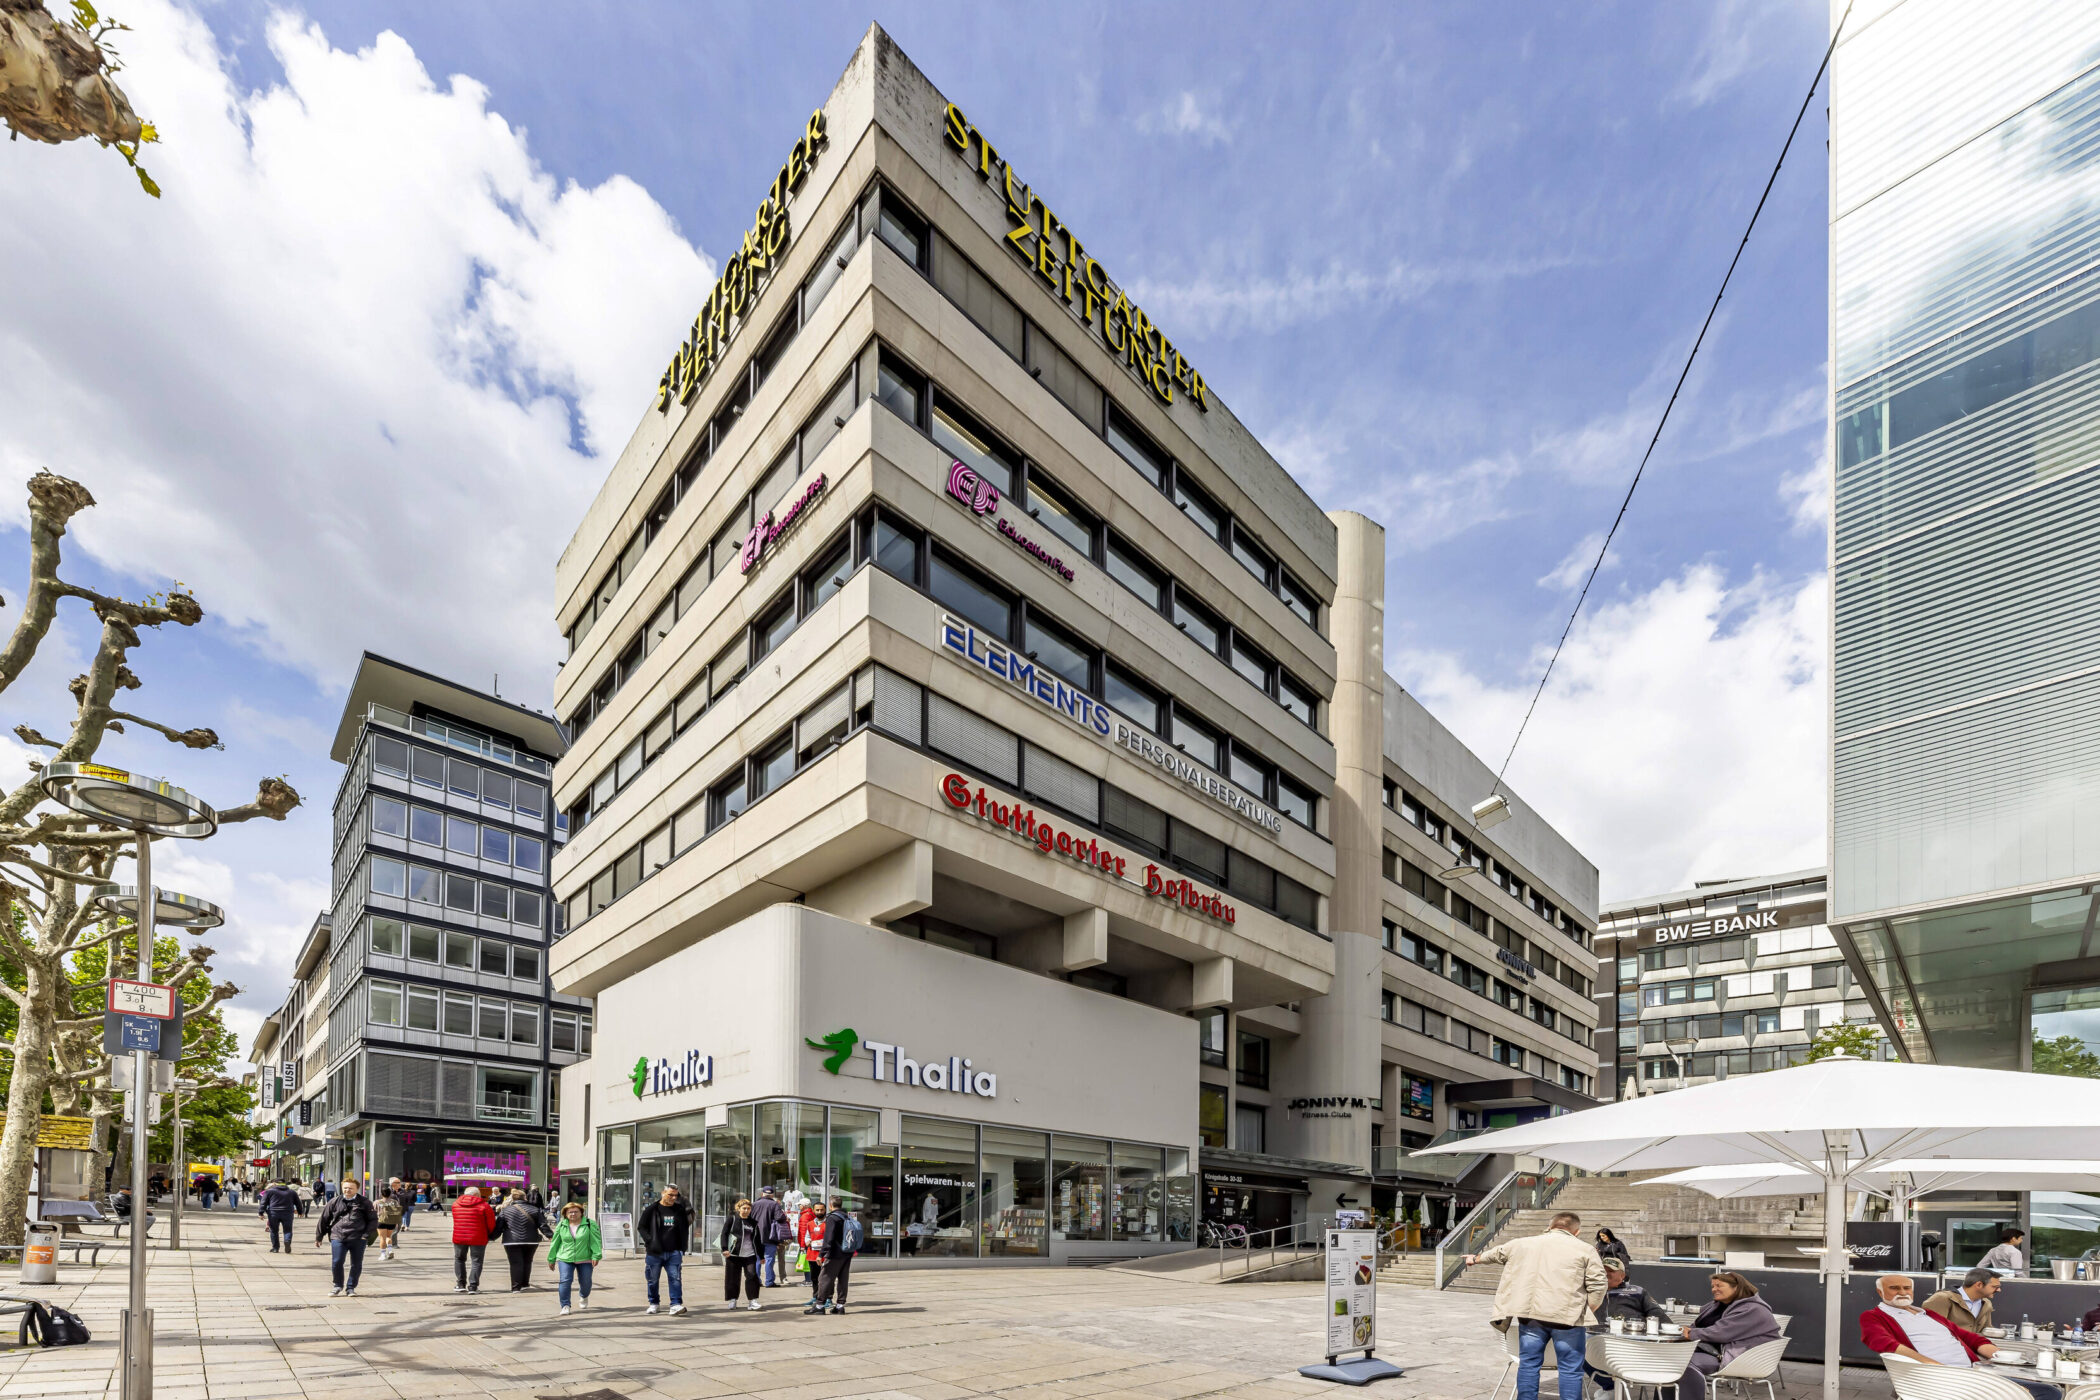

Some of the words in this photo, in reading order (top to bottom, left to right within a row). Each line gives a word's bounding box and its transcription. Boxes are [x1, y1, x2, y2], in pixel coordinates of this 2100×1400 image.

[657, 108, 828, 412] STUTTGARTER
[944, 102, 1209, 413] STUTTGARTER
[679, 206, 790, 406] ZEITUNG
[1003, 204, 1173, 405] ZEITUNG
[942, 613, 1110, 736] ELEMENTS
[1114, 723, 1282, 833] PERSONALBERATUNG
[938, 773, 1126, 878] Stuttgarter
[1141, 863, 1236, 924] Hofbräu
[1714, 910, 1778, 935] BANK
[133, 985, 156, 995] 400
[285, 1063, 294, 1087] LUSH
[647, 1049, 713, 1094] Thalia
[863, 1040, 997, 1098] Thalia
[1288, 1096, 1349, 1110] JONNY
[1351, 1097, 1367, 1109] M.
[450, 1165, 474, 1173] Jetzt
[476, 1166, 526, 1176] informieren
[904, 1174, 953, 1186] Spielwaren
